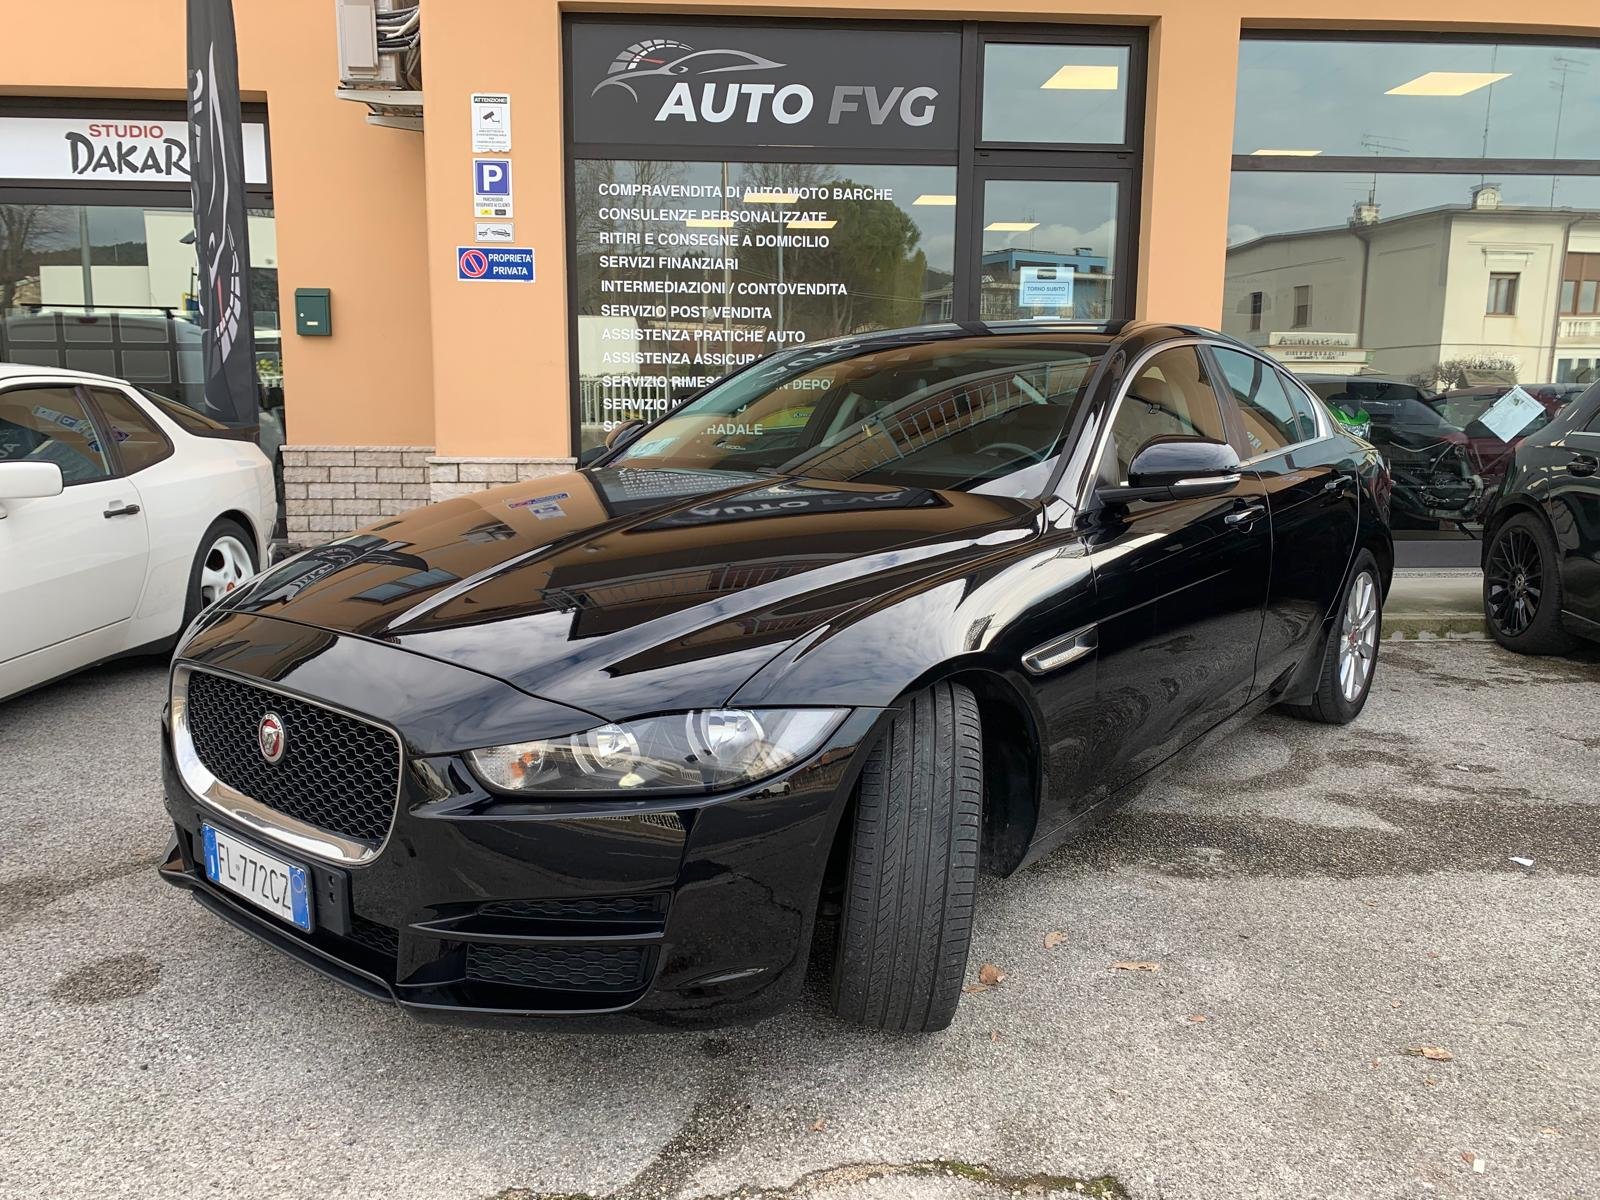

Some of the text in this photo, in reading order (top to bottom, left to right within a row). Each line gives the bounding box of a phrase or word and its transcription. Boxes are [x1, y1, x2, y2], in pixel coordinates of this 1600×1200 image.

[654, 82, 940, 127] AUTO FVG
[88, 123, 164, 139] STUDIO
[65, 131, 191, 175] DAKAR
[482, 164, 503, 191] P
[598, 183, 893, 201] COMPRAVENDITA DI AUTO MOTO BARCHE
[598, 208, 828, 225] CONSULENZE PERSONALIZZATE
[599, 231, 830, 248] RITIRI E CONSEGNE A DOMICILIO
[488, 253, 533, 263] PROPRIETA'
[599, 255, 739, 270] SERVIZI FINANZIARI
[493, 266, 528, 275] PRIVATA
[601, 280, 726, 294] INTERMEDIAZIONI
[738, 282, 848, 296] CONTOVENDITA
[601, 304, 773, 319] SERVIZIO POST VENDITA
[602, 328, 806, 343] ASSISTENZA PRATICHE AUTO
[602, 352, 690, 365] ASSISTENZA
[602, 376, 668, 389] SERVIZIO
[793, 379, 834, 391] DEPO
[603, 398, 668, 411] SERVIZIO
